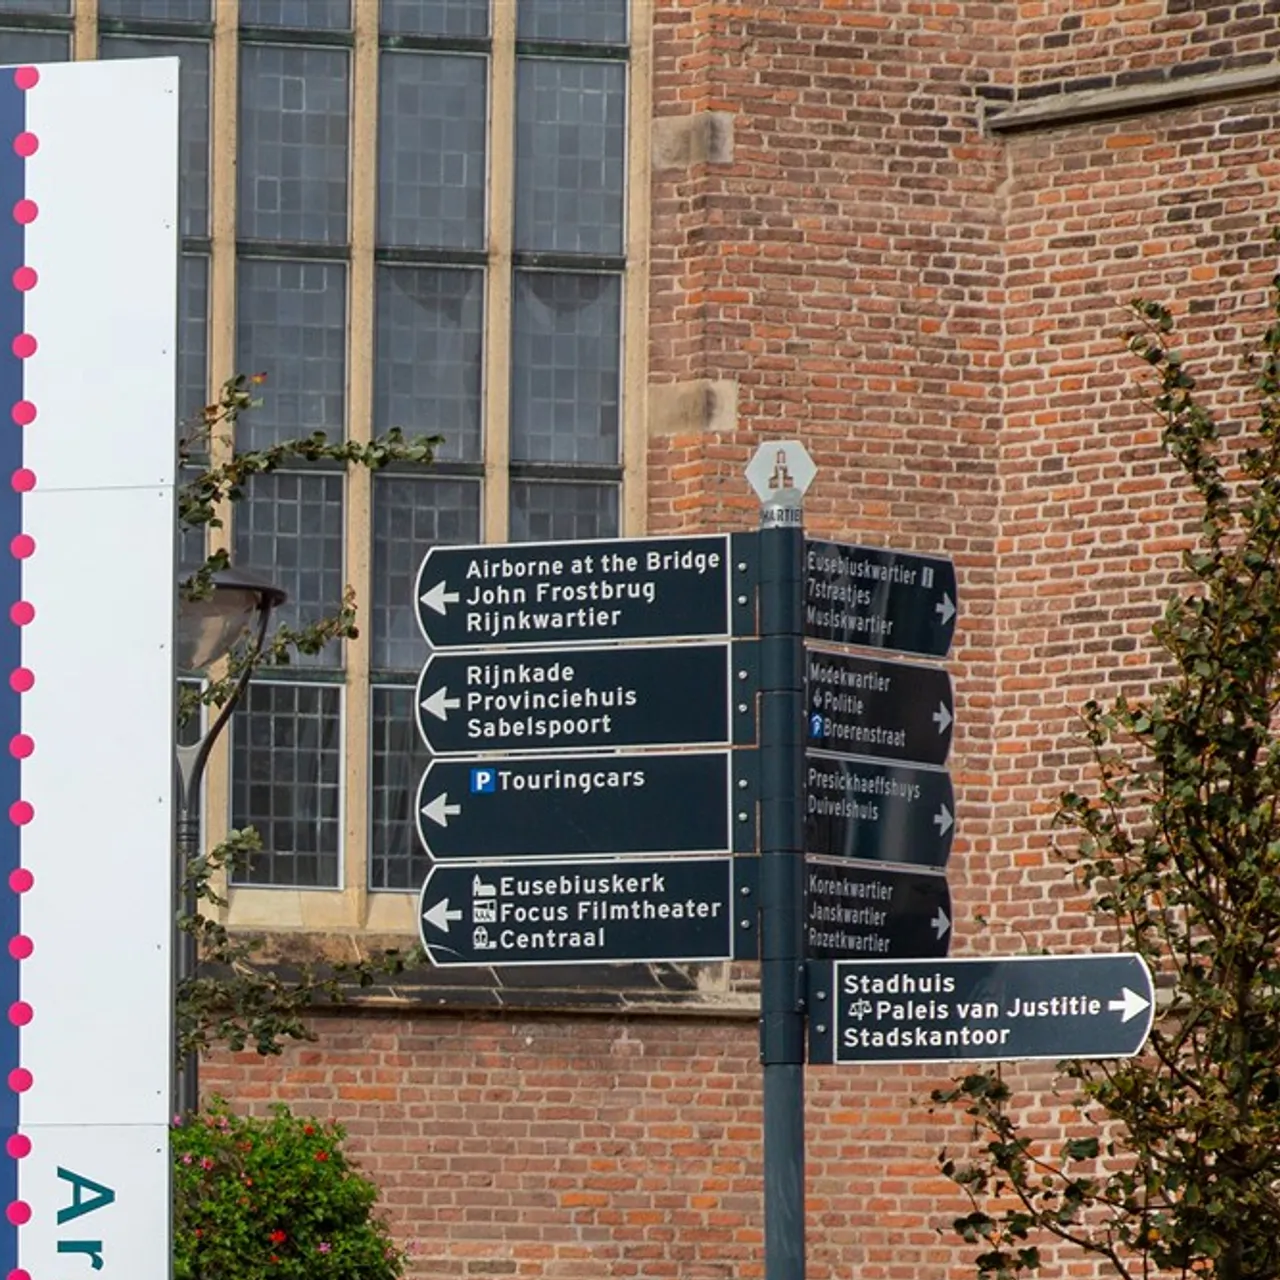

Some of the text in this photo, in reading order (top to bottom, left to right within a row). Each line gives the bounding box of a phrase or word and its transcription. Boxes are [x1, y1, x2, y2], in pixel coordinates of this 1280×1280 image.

[466, 551, 720, 579] Airborne at the Bridge
[807, 551, 917, 585] Eusebiuskwartier
[466, 580, 655, 605] John Frostbrug
[467, 607, 621, 636] Rijnkwartier
[806, 605, 893, 635] Musiskwartier
[467, 663, 574, 689] Rijnkade
[810, 663, 890, 692] Modekwartier
[468, 687, 637, 712] Provinciehuis
[824, 691, 864, 714] Politie
[468, 714, 612, 738] Sabelspoort
[824, 718, 906, 747] Broerenstraat
[499, 769, 645, 793] Touringcars
[808, 795, 878, 821] Duivelshuis
[501, 873, 665, 897] Eusebiuskerk
[809, 874, 894, 900] Korenkwartier
[501, 900, 722, 923] Focus Filmtheater
[809, 901, 887, 926] Janskwartier
[501, 928, 604, 949] Centraal
[844, 974, 955, 995] Stadhuis
[877, 996, 1100, 1021] Paleis van Justitie
[844, 1027, 1010, 1047] Stadskantoor
